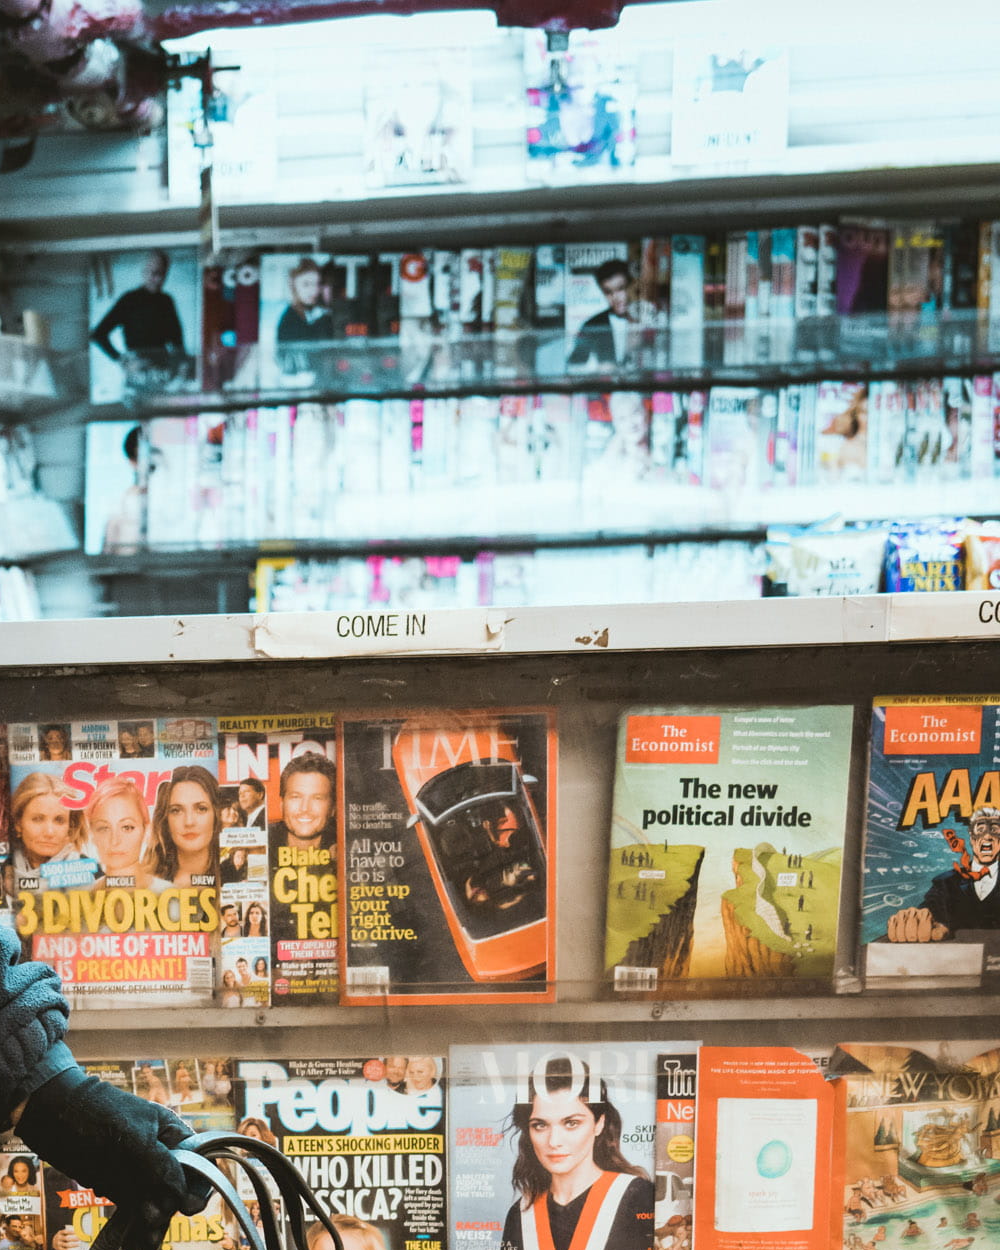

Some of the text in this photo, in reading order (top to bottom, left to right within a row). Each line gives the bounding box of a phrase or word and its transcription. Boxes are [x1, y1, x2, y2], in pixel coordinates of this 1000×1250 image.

[337, 614, 426, 638] COME IN
[921, 715, 948, 728] The
[661, 724, 687, 738] The
[890, 730, 976, 743] Economist
[631, 738, 714, 754] Economist
[60, 761, 174, 812] Star
[680, 777, 779, 800] The new
[642, 804, 813, 829] political divide
[352, 839, 402, 858] All you
[278, 846, 331, 867] Blake
[350, 855, 405, 868] have to
[20, 878, 39, 889] CAM
[106, 876, 136, 888] NICOLE
[191, 875, 216, 887] DREW
[350, 869, 385, 883] do is
[350, 885, 410, 900] give up
[17, 888, 221, 937] 3 DIVORCES
[351, 900, 390, 915] your
[351, 912, 391, 928] right
[351, 927, 418, 942] to drive.
[36, 934, 206, 958] AND ONE OF THEM
[56, 958, 184, 981] IS PREGNANT!
[238, 1062, 444, 1137] People
[288, 1139, 295, 1152] A
[297, 1138, 334, 1152] TEEN'S
[336, 1138, 391, 1151] SHOCKING
[394, 1137, 440, 1150] MURDER
[290, 1155, 349, 1189] WHO
[353, 1154, 443, 1188] KILLED
[69, 1192, 93, 1208] BEN
[455, 1221, 504, 1231] RACHEL
[455, 1231, 493, 1240] WEISZ
[405, 1240, 441, 1250] THE CLUE
